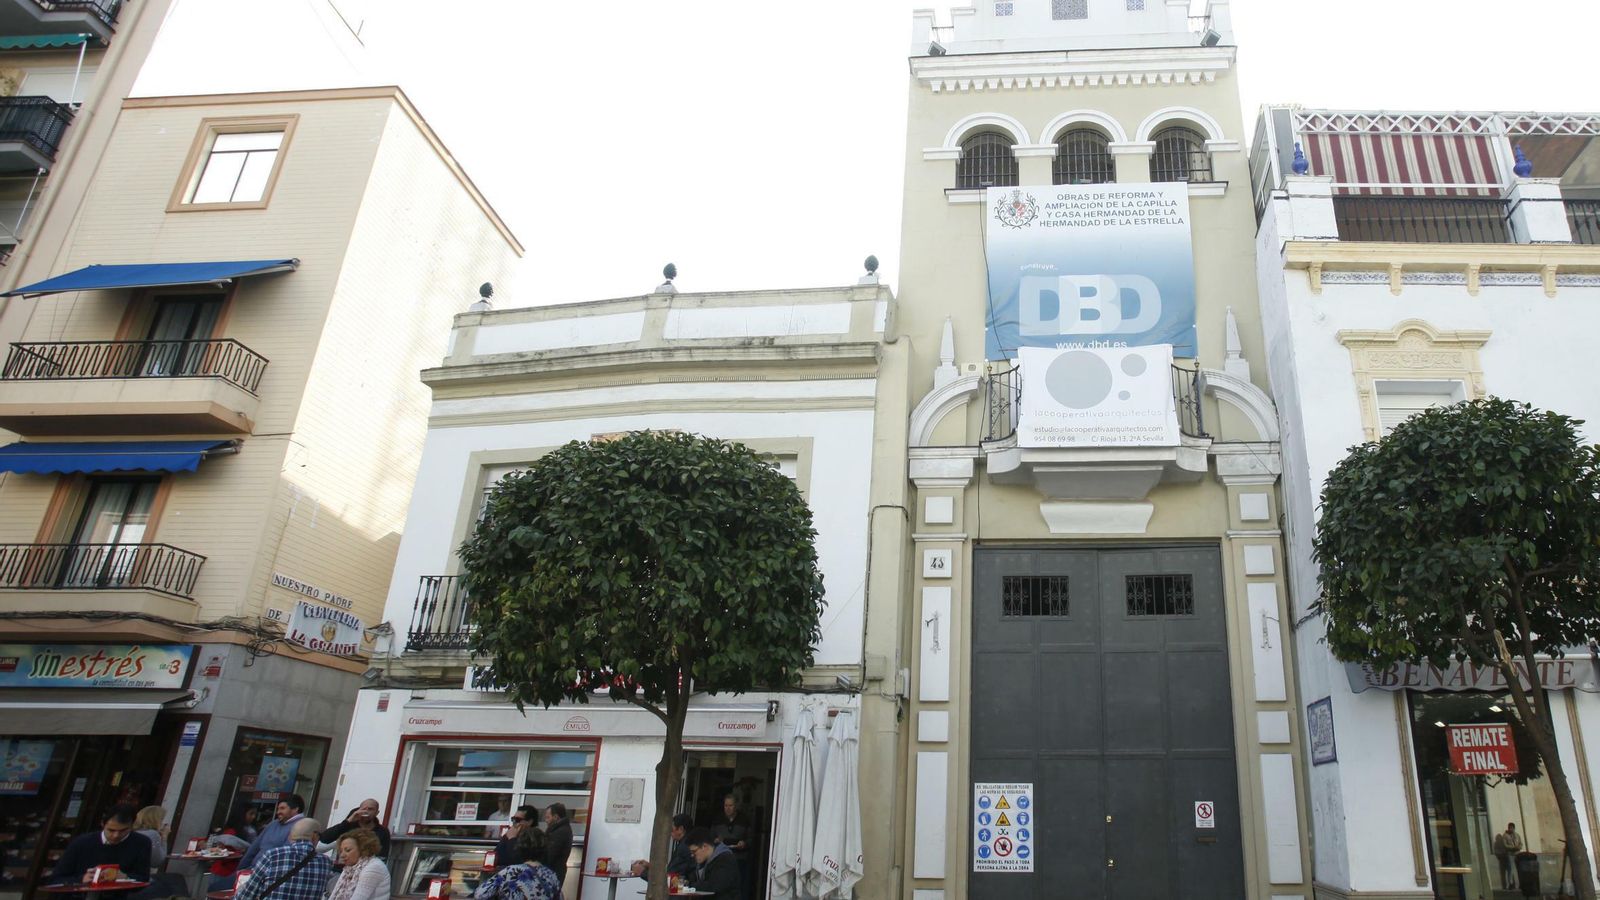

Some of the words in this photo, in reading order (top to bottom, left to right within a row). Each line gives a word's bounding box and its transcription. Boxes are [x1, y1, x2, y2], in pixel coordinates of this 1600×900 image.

[1057, 193, 1090, 201] OBRAS
[1084, 210, 1145, 218] HERMANDAD
[1134, 218, 1184, 226] ESTRELLA
[1019, 274, 1162, 336] DBD
[1056, 340, 1128, 350] www.dbd.es
[274, 574, 320, 598] NUESTRO
[324, 592, 353, 610] PADRE
[268, 608, 282, 621] DE
[290, 628, 306, 645] LA
[309, 638, 358, 655] GRANDE
[29, 644, 146, 678] sinestrés
[408, 717, 442, 726] Cruzcampo
[718, 721, 756, 730] Cruzcampo
[1451, 728, 1508, 747] REMATE
[1462, 751, 1505, 770] FINAL
